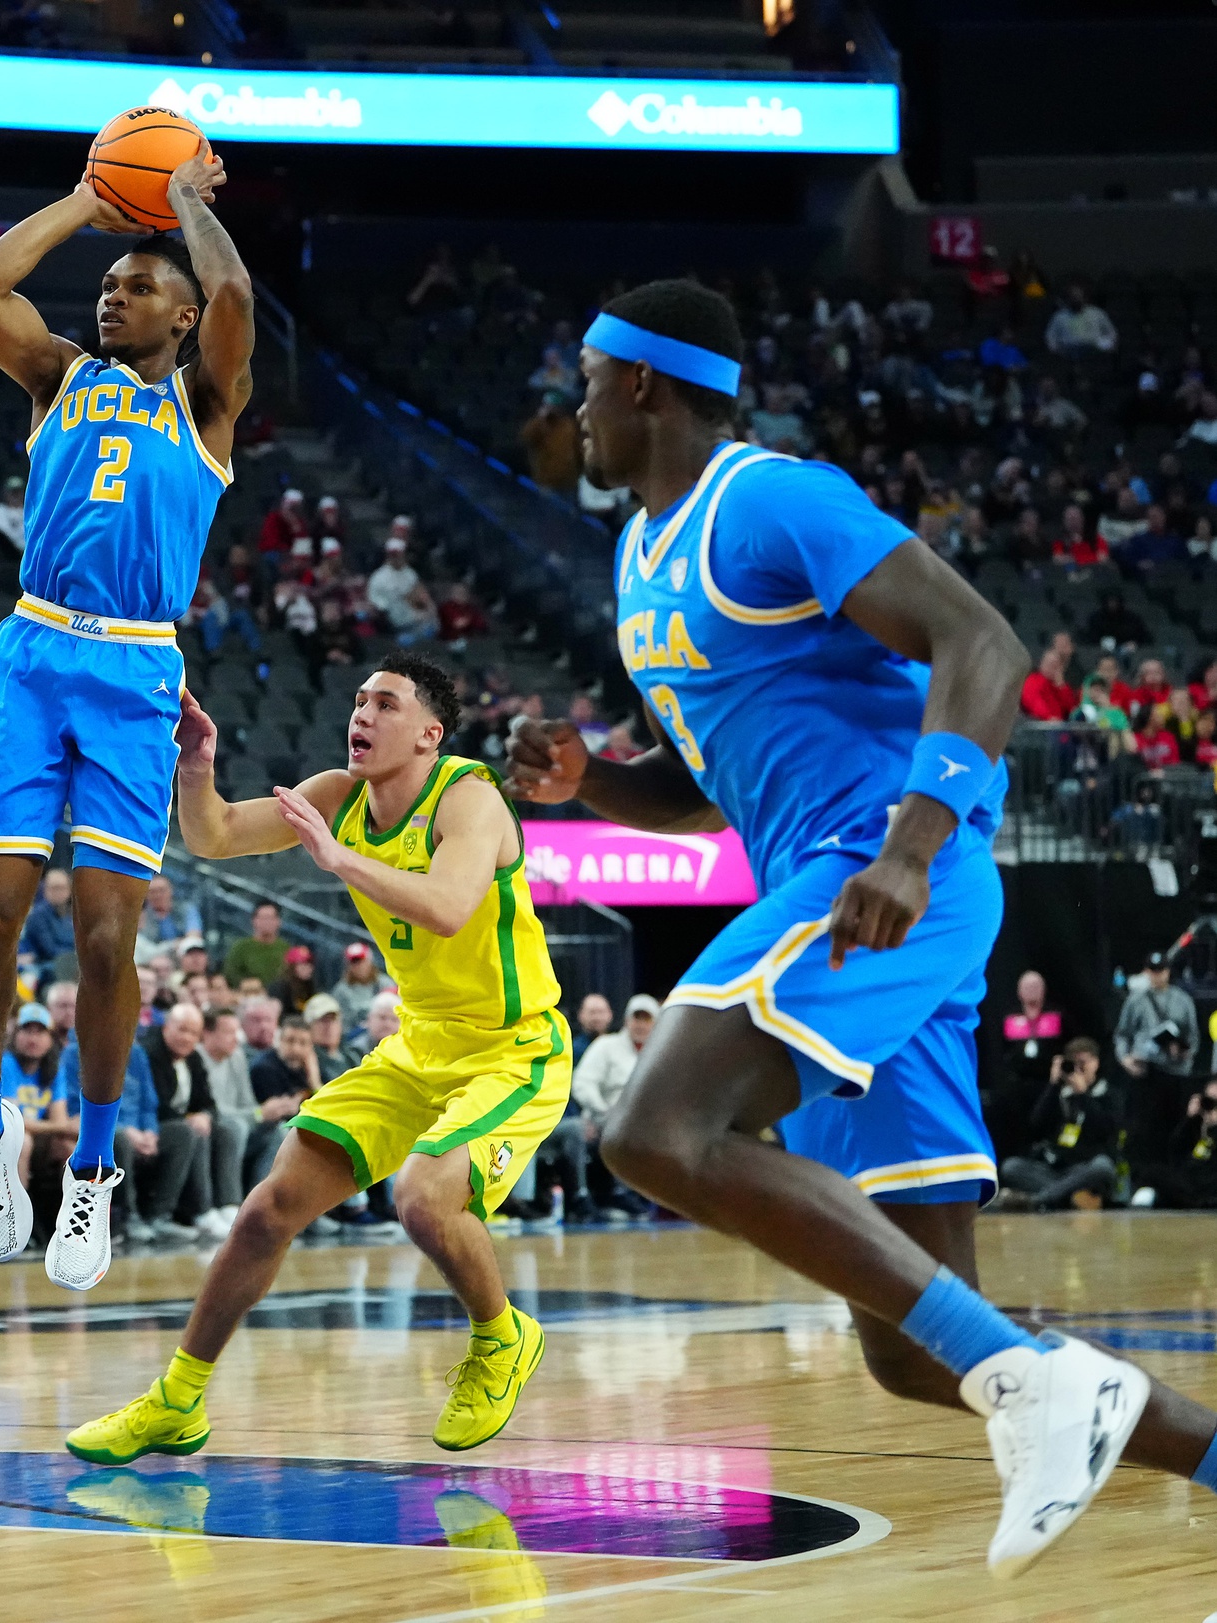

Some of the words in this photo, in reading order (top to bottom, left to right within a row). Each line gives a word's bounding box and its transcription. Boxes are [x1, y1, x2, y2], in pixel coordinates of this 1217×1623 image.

[188, 82, 363, 128] Columbia
[630, 93, 804, 137] Columbia
[935, 221, 974, 257] 12
[61, 383, 181, 447] UCLA
[89, 435, 133, 503] 2
[71, 614, 103, 635] Ucla
[617, 609, 712, 680] CLA
[648, 683, 707, 772] 3
[578, 853, 695, 883] ARENA
